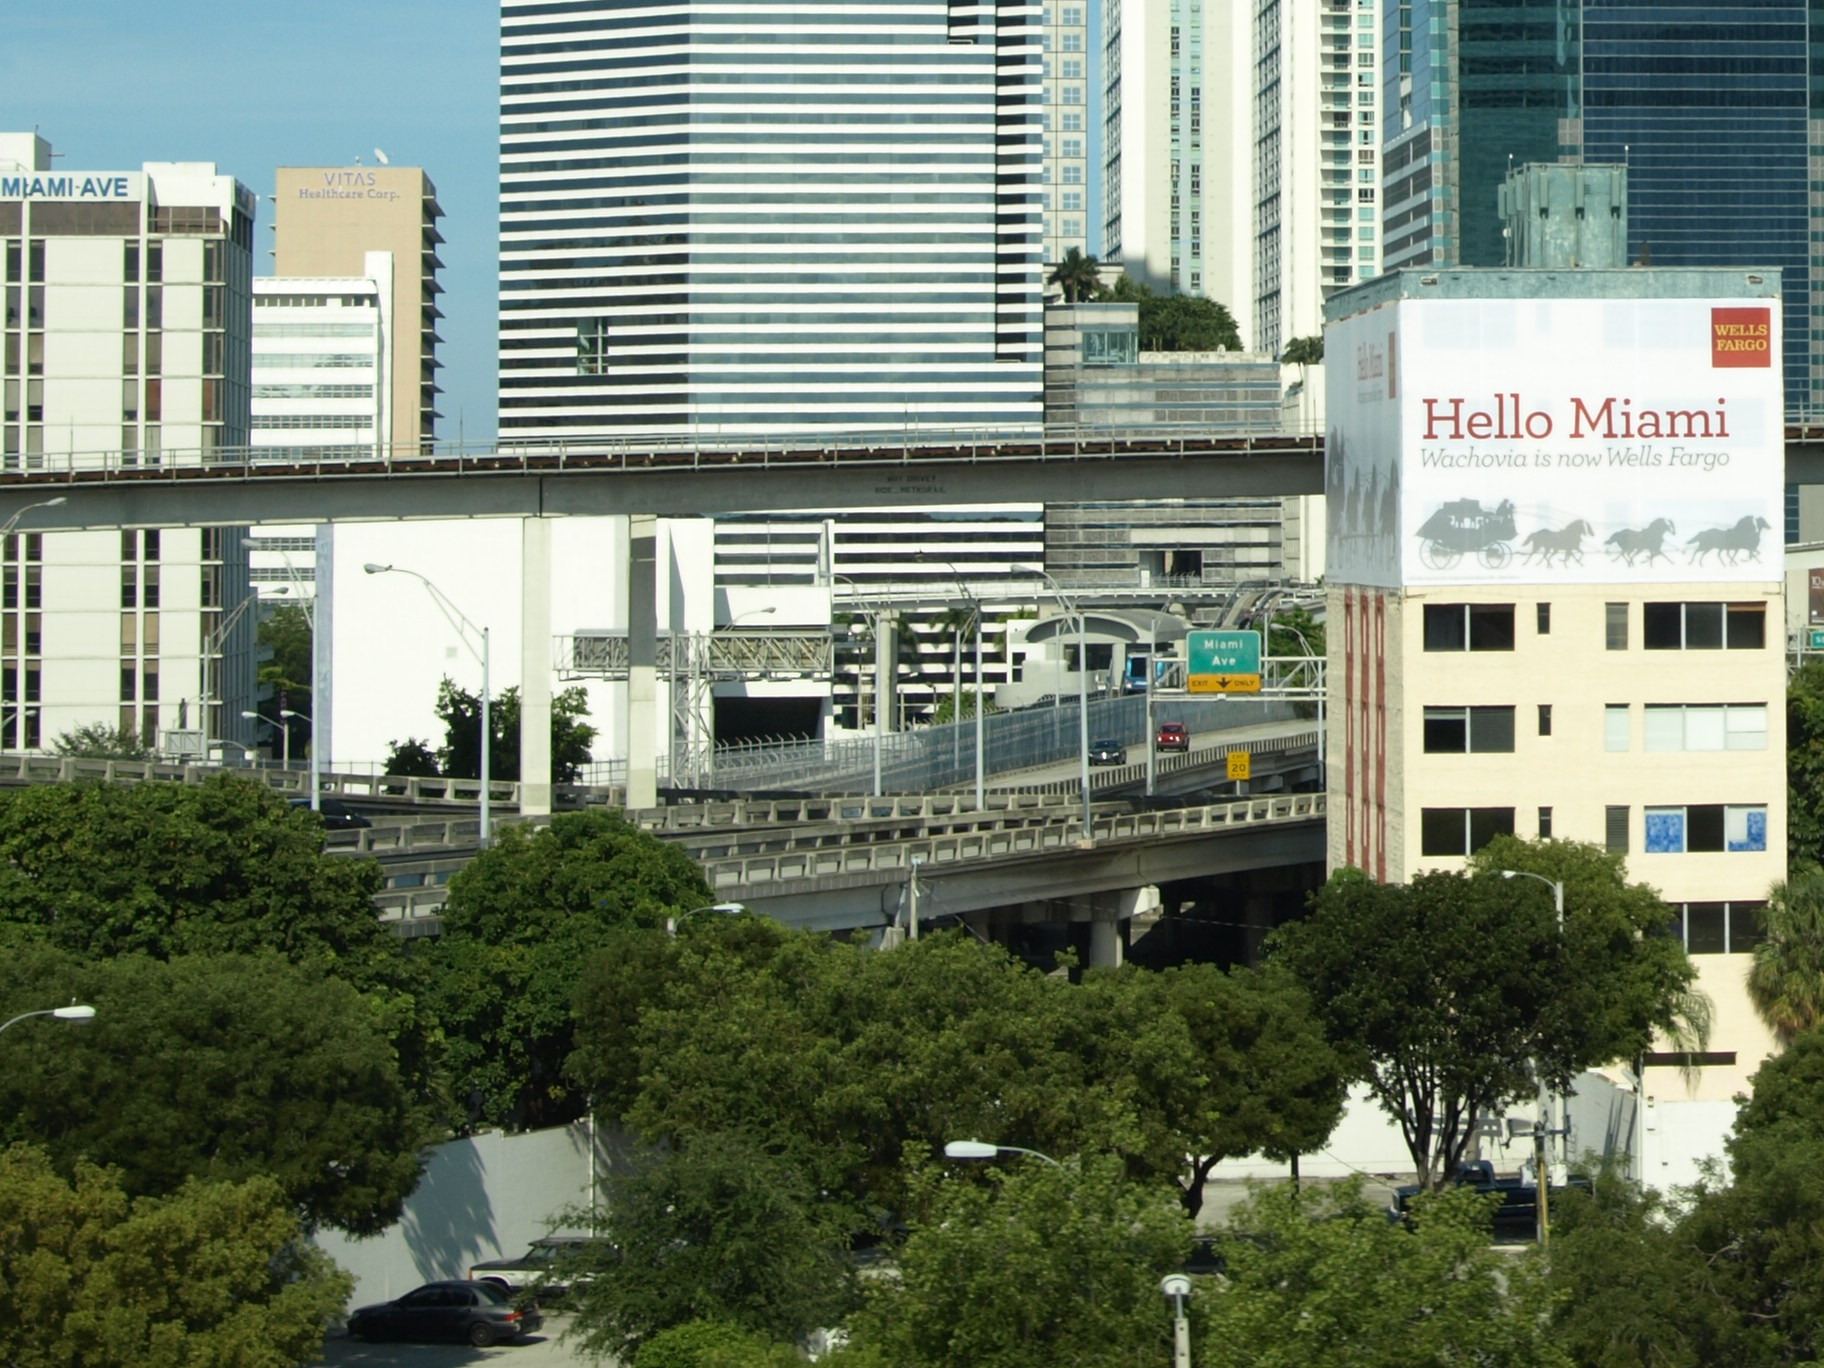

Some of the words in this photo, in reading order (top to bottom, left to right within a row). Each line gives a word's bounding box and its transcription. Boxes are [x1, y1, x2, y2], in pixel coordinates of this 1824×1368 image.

[324, 172, 376, 186] VITAS
[2, 177, 73, 198] MIAMI
[80, 177, 128, 197] AVE
[299, 188, 364, 199] Healthcare
[367, 188, 400, 202] Corp.
[1713, 324, 1768, 336] WELLS
[1715, 339, 1768, 351] FARGO
[1422, 393, 1553, 440] Hello
[1569, 397, 1730, 439] Miami
[1420, 446, 1528, 469] Wachovia
[1534, 448, 1552, 468] is
[1558, 451, 1602, 468] now
[1606, 445, 1662, 467] Wells
[1668, 447, 1730, 472] Fargo
[1204, 639, 1243, 649] Miami
[1212, 655, 1236, 665] Ave
[1233, 679, 1255, 687] ONLY
[1232, 763, 1246, 773] 20
